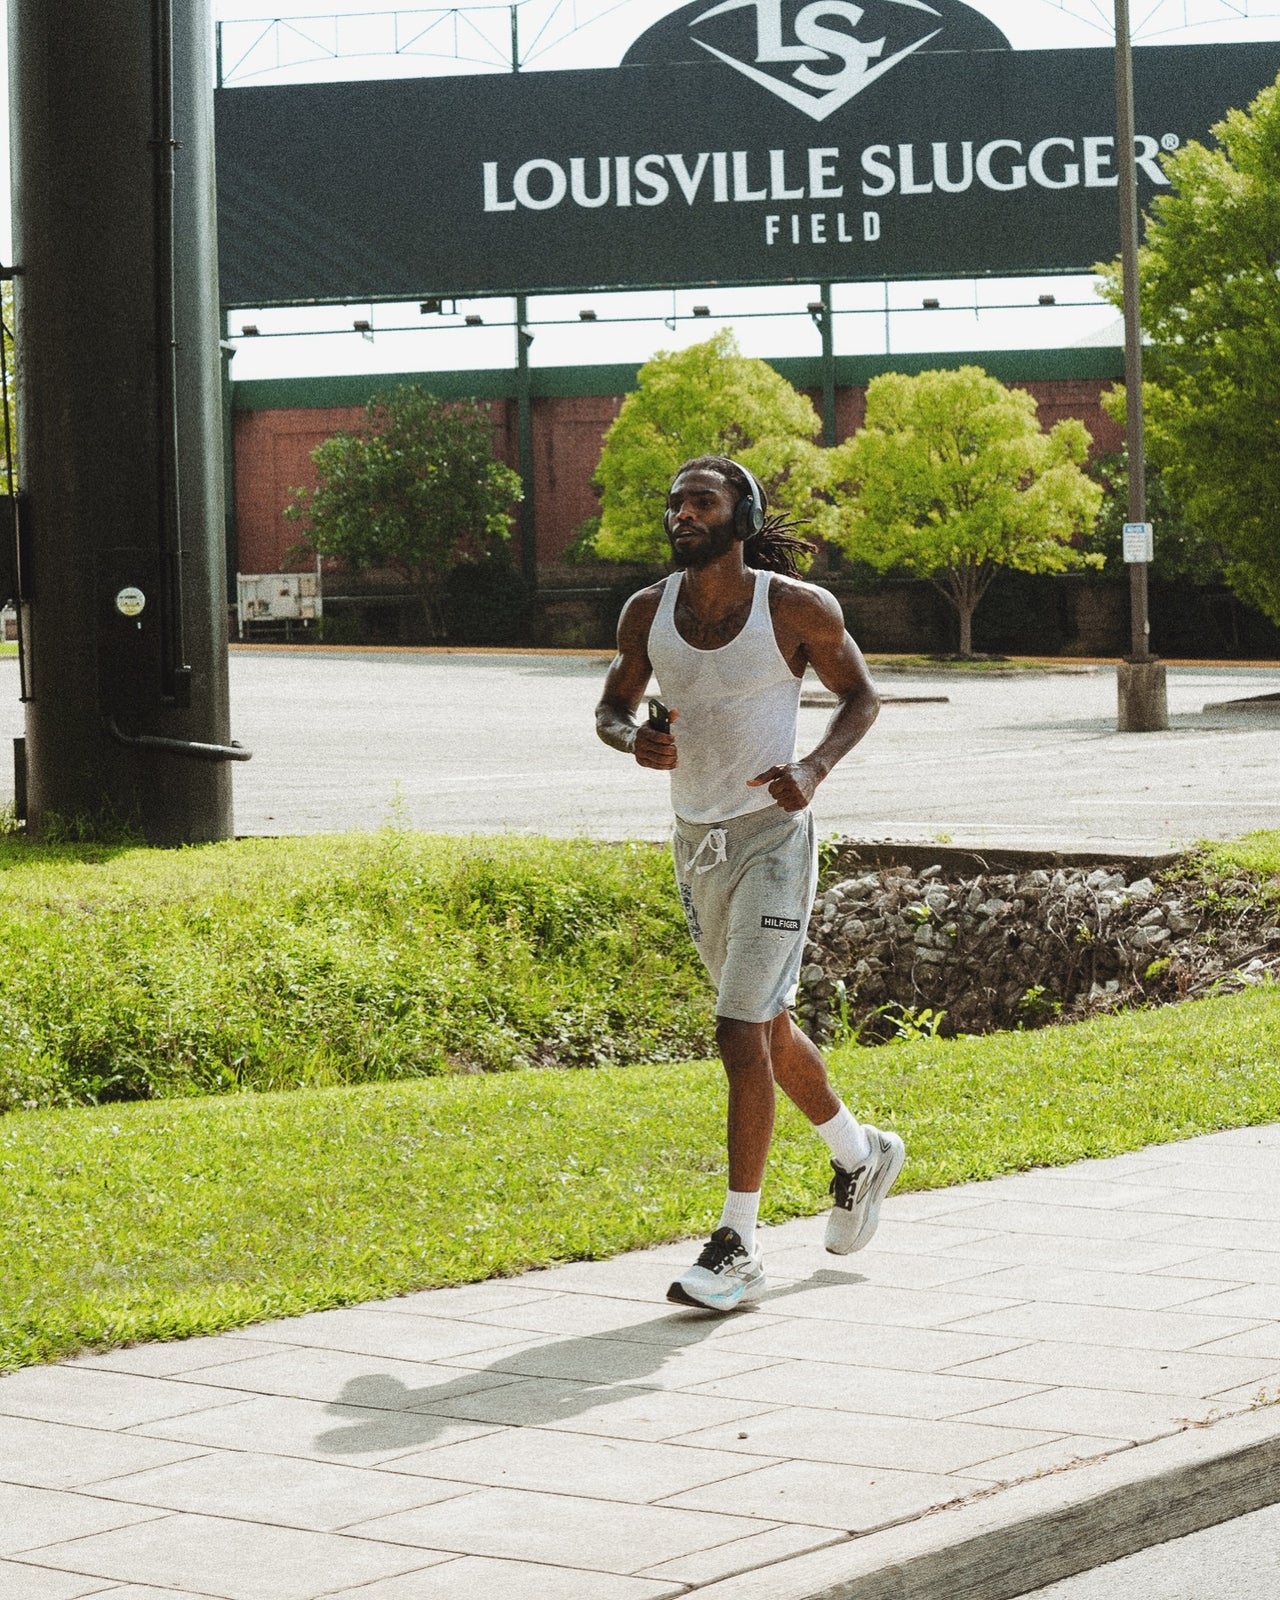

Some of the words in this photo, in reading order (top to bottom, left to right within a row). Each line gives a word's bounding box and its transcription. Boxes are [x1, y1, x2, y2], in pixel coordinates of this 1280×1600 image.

[483, 147, 844, 211] LOUISVILLE
[765, 211, 881, 245] FIELD
[765, 918, 798, 928] HILFIGER
